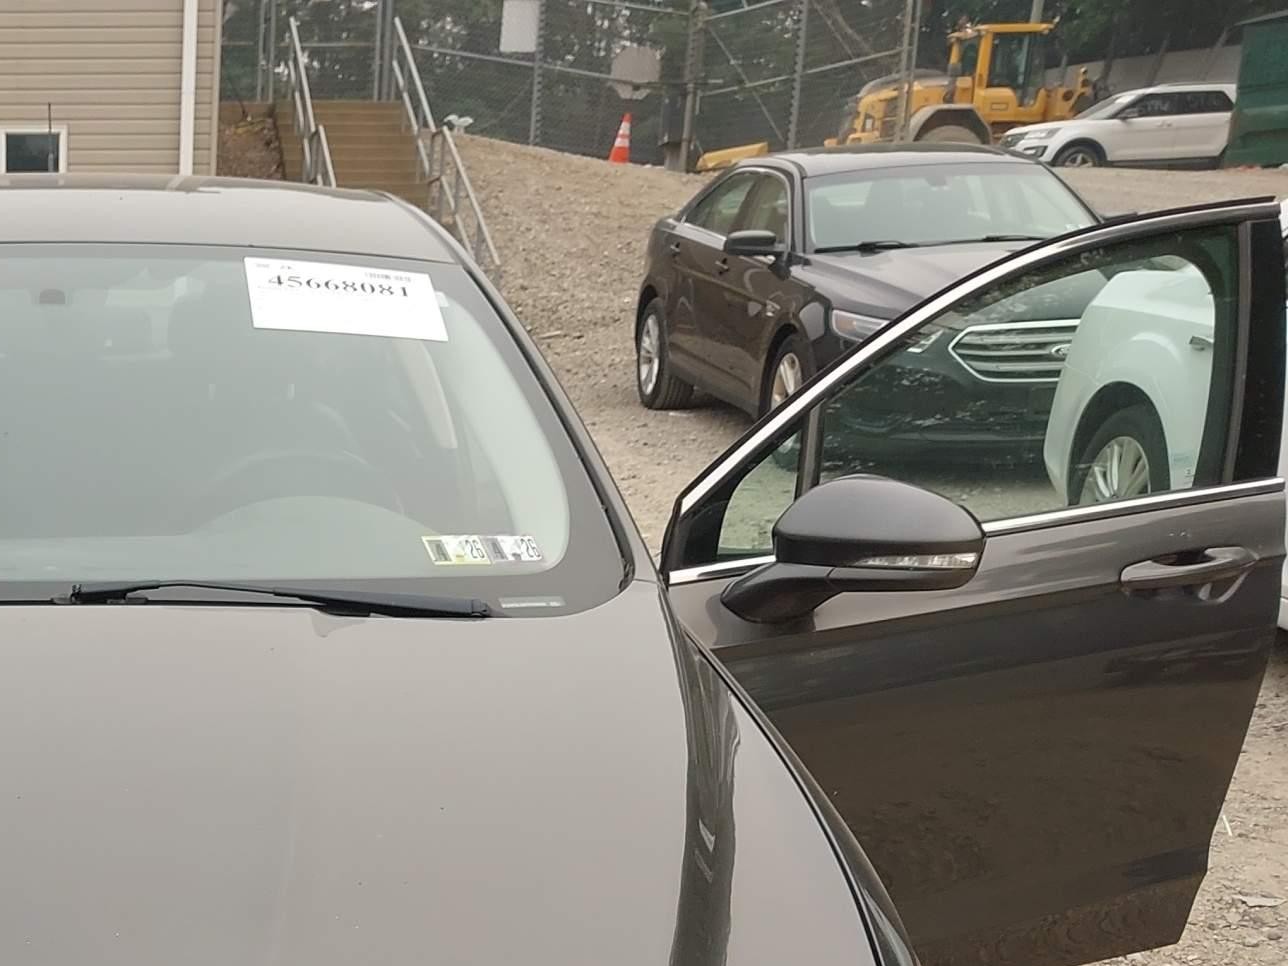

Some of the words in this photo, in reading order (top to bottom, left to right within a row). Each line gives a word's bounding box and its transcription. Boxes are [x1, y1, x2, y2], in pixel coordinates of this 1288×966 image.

[267, 274, 409, 298] 45668081
[464, 538, 486, 559] 26
[520, 537, 542, 559] 26
